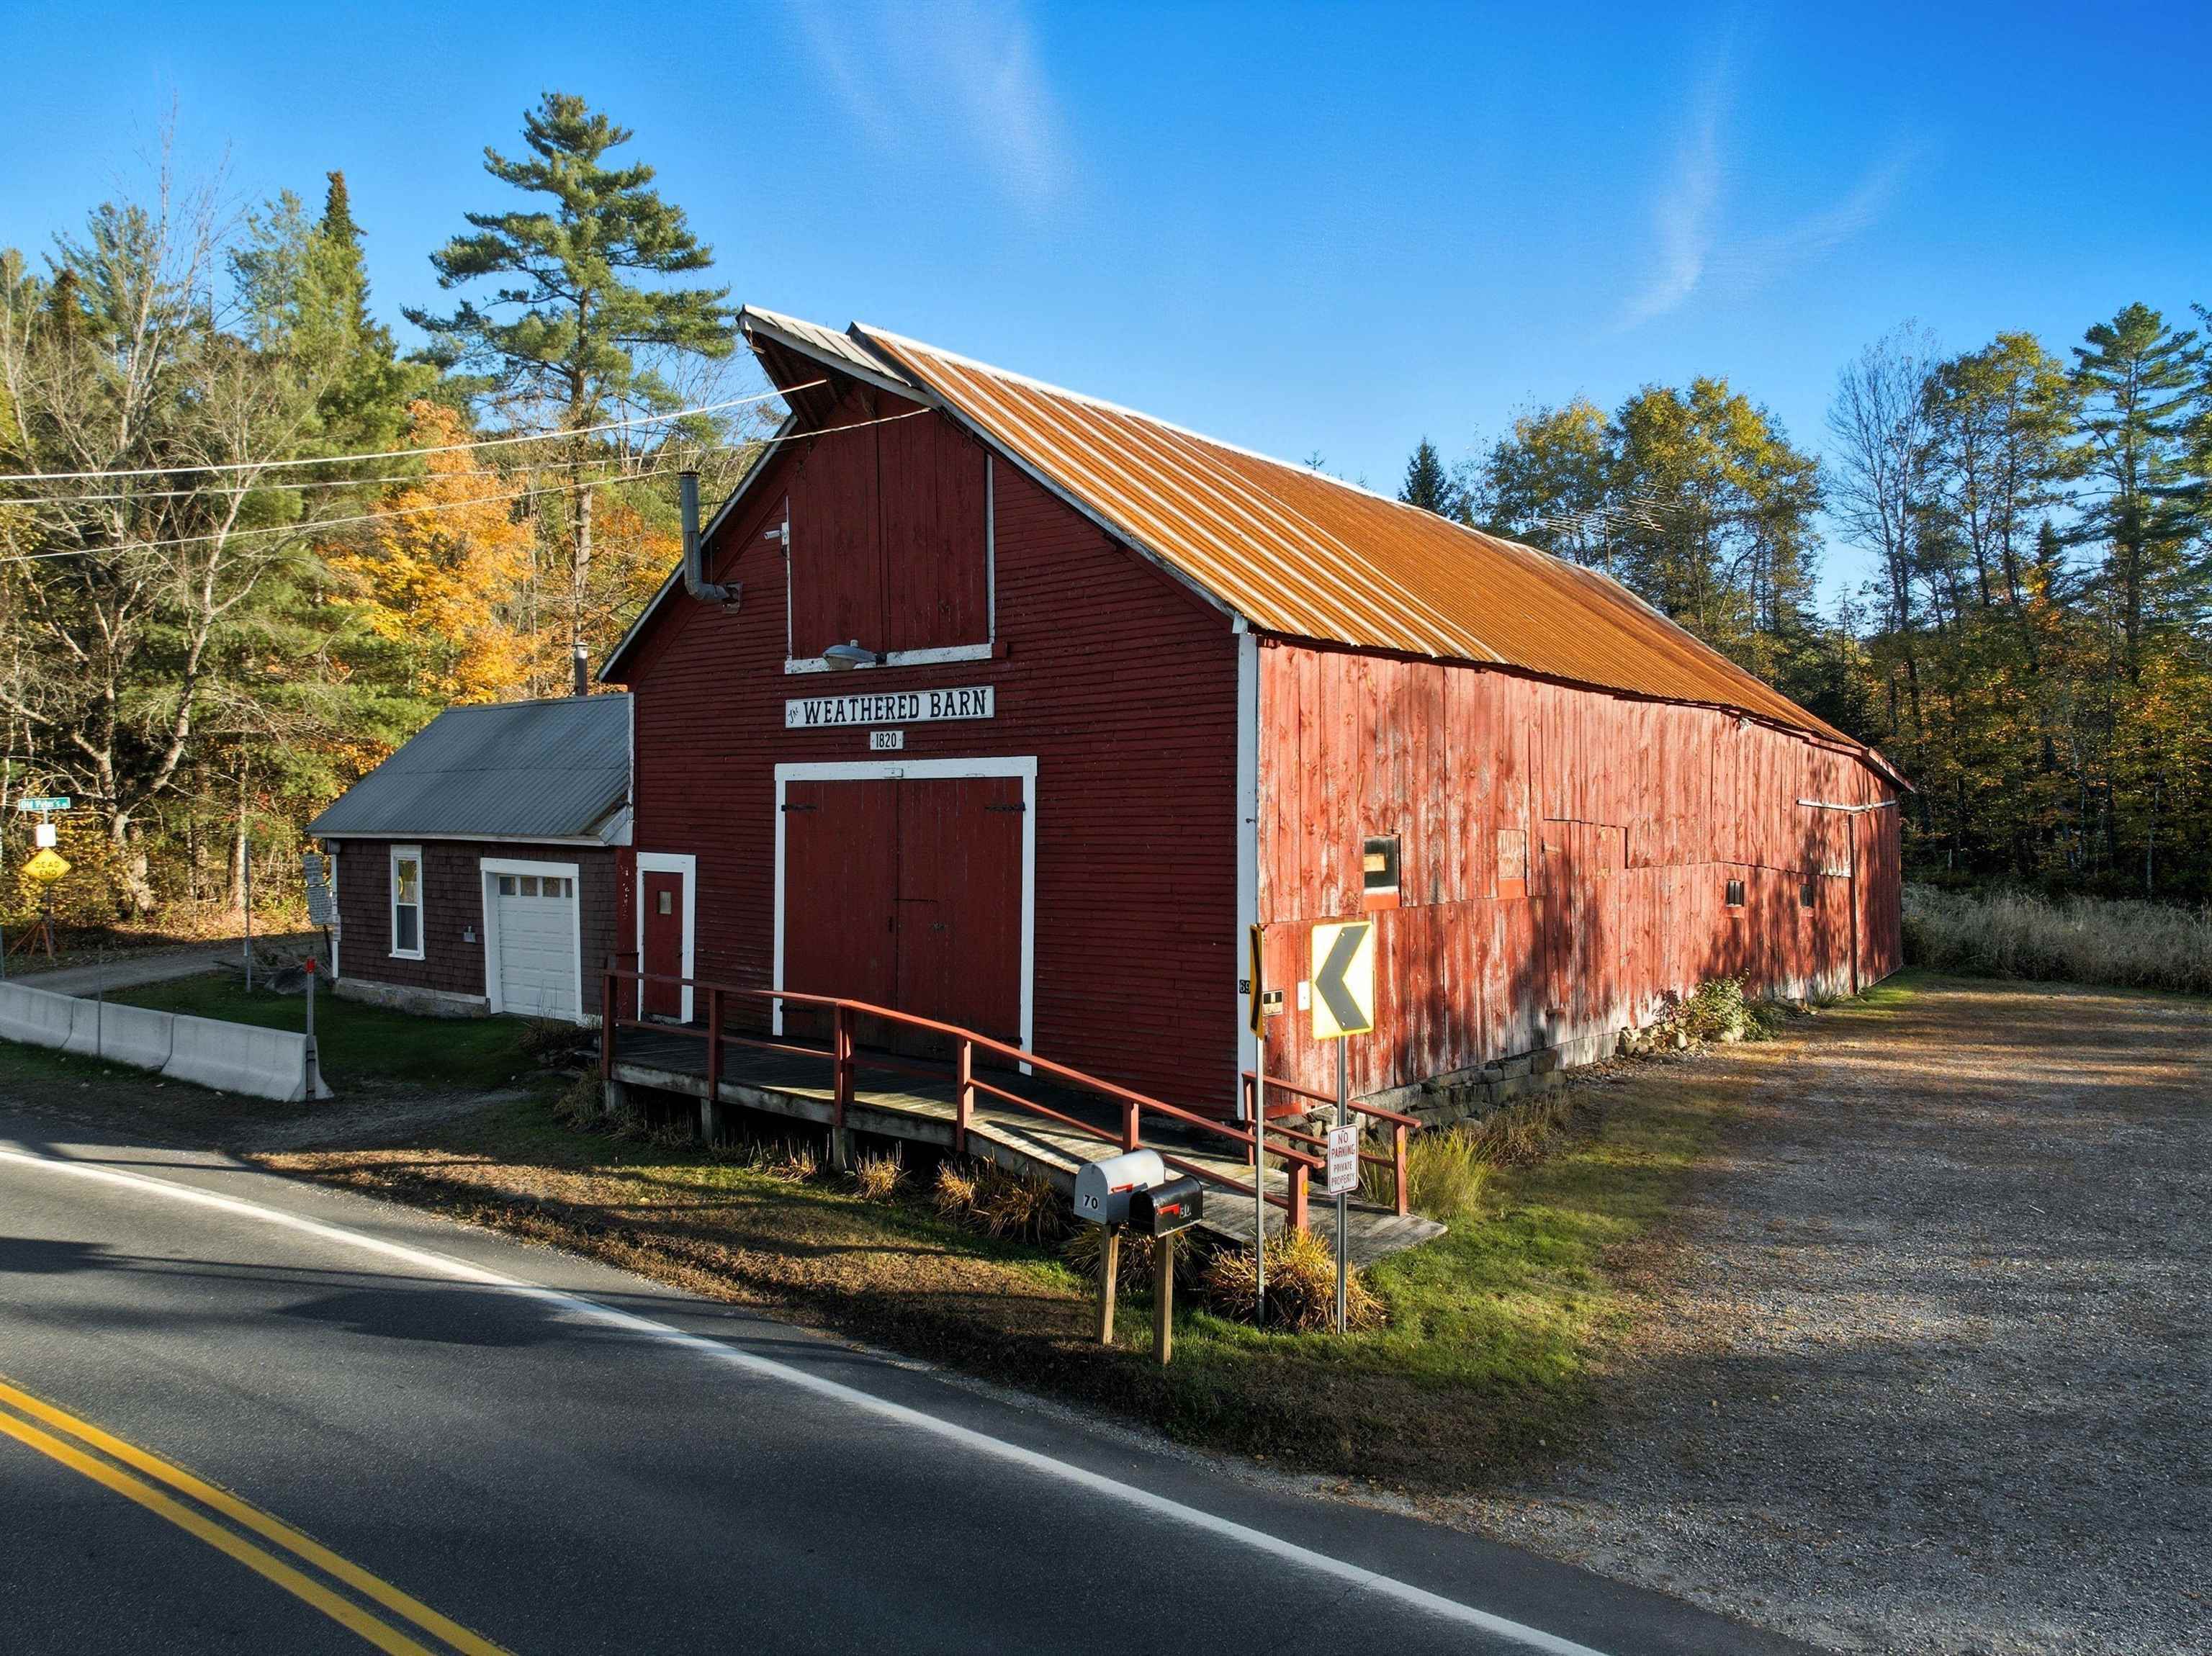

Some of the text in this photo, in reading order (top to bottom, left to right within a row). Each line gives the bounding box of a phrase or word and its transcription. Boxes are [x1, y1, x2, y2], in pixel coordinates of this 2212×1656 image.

[803, 694, 920, 724] WEATHERED
[930, 689, 986, 719] BARN
[876, 733, 897, 748] 1820
[1239, 981, 1251, 993] 69
[1338, 1133, 1349, 1143] NO
[1331, 1144, 1355, 1158] PARKING
[1334, 1161, 1352, 1172] PRIVATE
[1331, 1174, 1354, 1186] PROPERTY
[1084, 1194, 1099, 1210] 70
